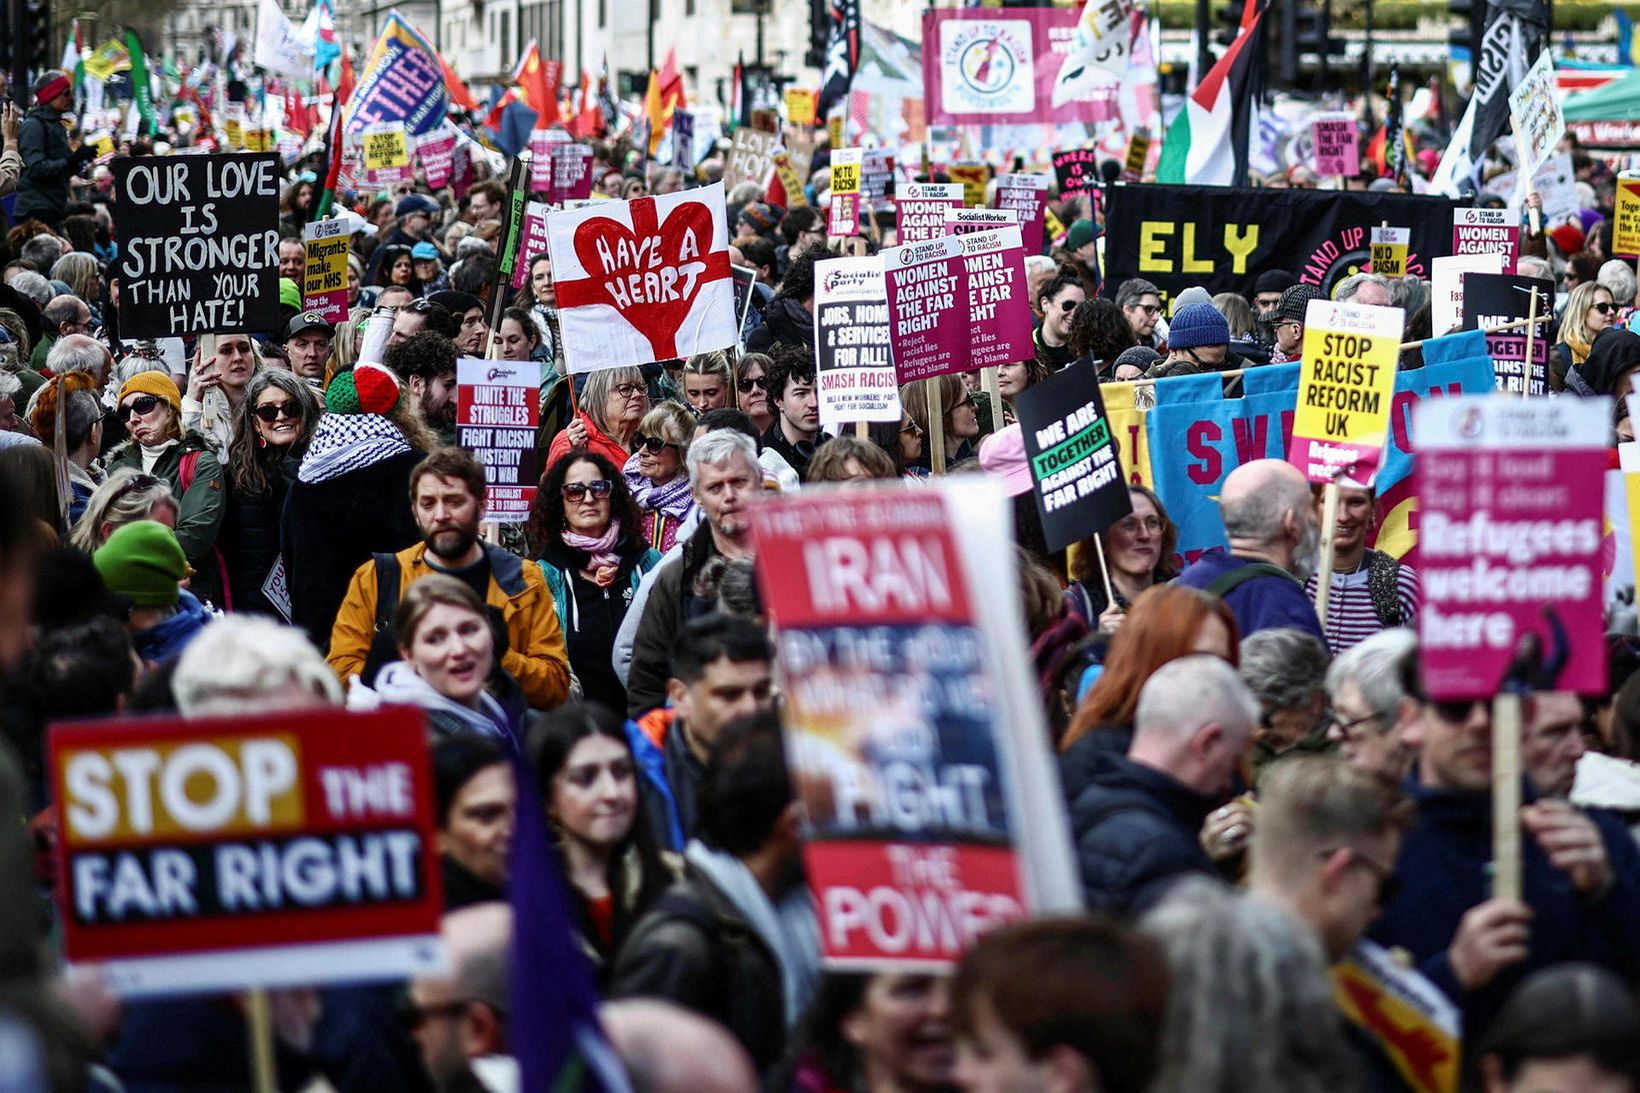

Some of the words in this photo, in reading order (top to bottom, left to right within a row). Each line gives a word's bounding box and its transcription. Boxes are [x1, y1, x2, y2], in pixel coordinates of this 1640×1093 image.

[732, 151, 771, 179] HOP
[844, 166, 852, 178] TO
[127, 162, 192, 205] OUR
[208, 160, 276, 200] LOVE
[833, 178, 856, 191] RACISM
[1065, 177, 1084, 188] OU
[181, 206, 218, 234] IS
[902, 214, 946, 226] AGAIN
[1619, 222, 1632, 232] the
[902, 227, 928, 239] THE
[932, 227, 946, 239] FA
[966, 236, 988, 246] STAND
[1458, 227, 1508, 240] WOMEN
[123, 230, 280, 278] STRONGER
[308, 240, 346, 260] Migrants
[596, 235, 663, 274] HAVE
[679, 226, 700, 262] A
[914, 244, 934, 254] STAND
[936, 242, 944, 250] UP
[916, 254, 924, 262] TO
[924, 249, 948, 260] RACISM
[968, 245, 976, 254] TO
[976, 240, 1002, 252] RACISM
[1139, 221, 1260, 275] ELY
[1299, 240, 1340, 286] TAND
[1341, 227, 1364, 250] UP
[1458, 240, 1514, 254] AGAINST
[307, 260, 331, 276] make
[894, 261, 948, 287] WOMEN
[968, 267, 1014, 290] AINST
[128, 277, 191, 306] THAN
[213, 272, 260, 299] YOUR
[306, 278, 322, 292] our
[324, 272, 342, 289] NHS
[604, 261, 707, 310] HEART
[896, 276, 958, 304] AGAINST
[981, 284, 1012, 304] FAR
[170, 299, 244, 333] HATE!
[821, 304, 853, 327] JOBS,
[856, 304, 889, 324] HOM
[896, 299, 924, 320] THE
[926, 294, 954, 312] FAR
[898, 312, 940, 336] RIGHT
[828, 330, 836, 346] &
[838, 327, 890, 346] SERVICE
[902, 335, 925, 348] Reject
[981, 334, 996, 342] lies
[1323, 334, 1372, 359] STOP
[834, 349, 858, 368] FOR
[860, 347, 888, 366] ALL!
[902, 345, 924, 358] racist
[925, 343, 938, 352] lies
[971, 345, 995, 356] ugees
[996, 342, 1010, 350] are
[984, 353, 1009, 362] blame
[904, 354, 937, 368] Refugees
[938, 352, 951, 360] are
[904, 369, 916, 378] not
[926, 362, 950, 372] blame
[822, 373, 856, 390] SMASH
[860, 372, 898, 388] RACIS
[1313, 358, 1380, 387] RACIST
[474, 386, 505, 405] UNITE
[506, 387, 527, 406] THE
[1507, 376, 1544, 396] RIHT
[1306, 384, 1380, 414] REFORM
[470, 404, 529, 425] STRUGGLES
[1325, 412, 1349, 437] UK
[1036, 420, 1066, 450] WE
[1066, 401, 1099, 437] ARE
[461, 428, 493, 447] FIGHT
[495, 429, 535, 448] RACISM
[1038, 426, 1106, 474] TOGETHER
[498, 466, 518, 483] WAR
[1041, 458, 1093, 494] AGAINST
[1093, 444, 1114, 467] THE
[489, 488, 494, 498] A
[495, 488, 522, 499] SOCIALIST
[1043, 482, 1077, 513] FAR
[1077, 460, 1118, 498] RIGHT
[1420, 510, 1599, 564] Refugees
[802, 536, 952, 614] IRAN
[1423, 558, 1591, 600] welcome
[1422, 603, 1514, 648] here
[64, 738, 298, 840] STOP
[319, 762, 414, 820] THE
[73, 848, 197, 922] FAR
[215, 829, 421, 913] RIGHT
